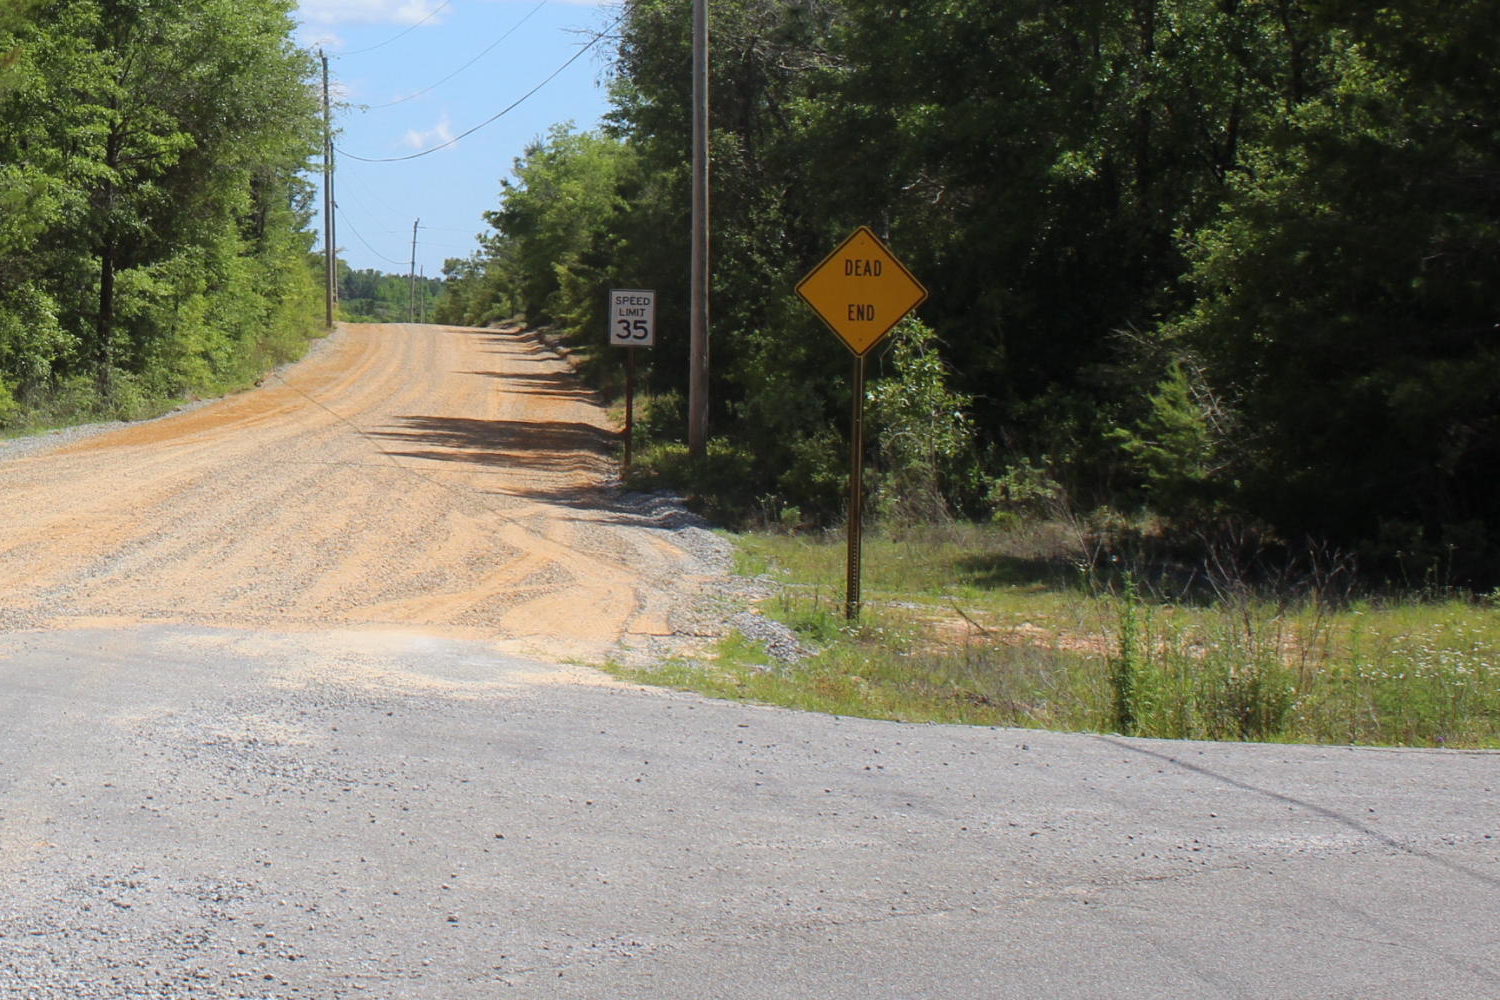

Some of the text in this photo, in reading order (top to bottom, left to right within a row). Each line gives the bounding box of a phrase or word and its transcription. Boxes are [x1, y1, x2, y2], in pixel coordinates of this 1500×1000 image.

[845, 259, 882, 277] DEAD
[615, 296, 651, 306] SPEED
[619, 307, 646, 317] LIMIT
[848, 304, 875, 321] END
[616, 319, 648, 340] 35
